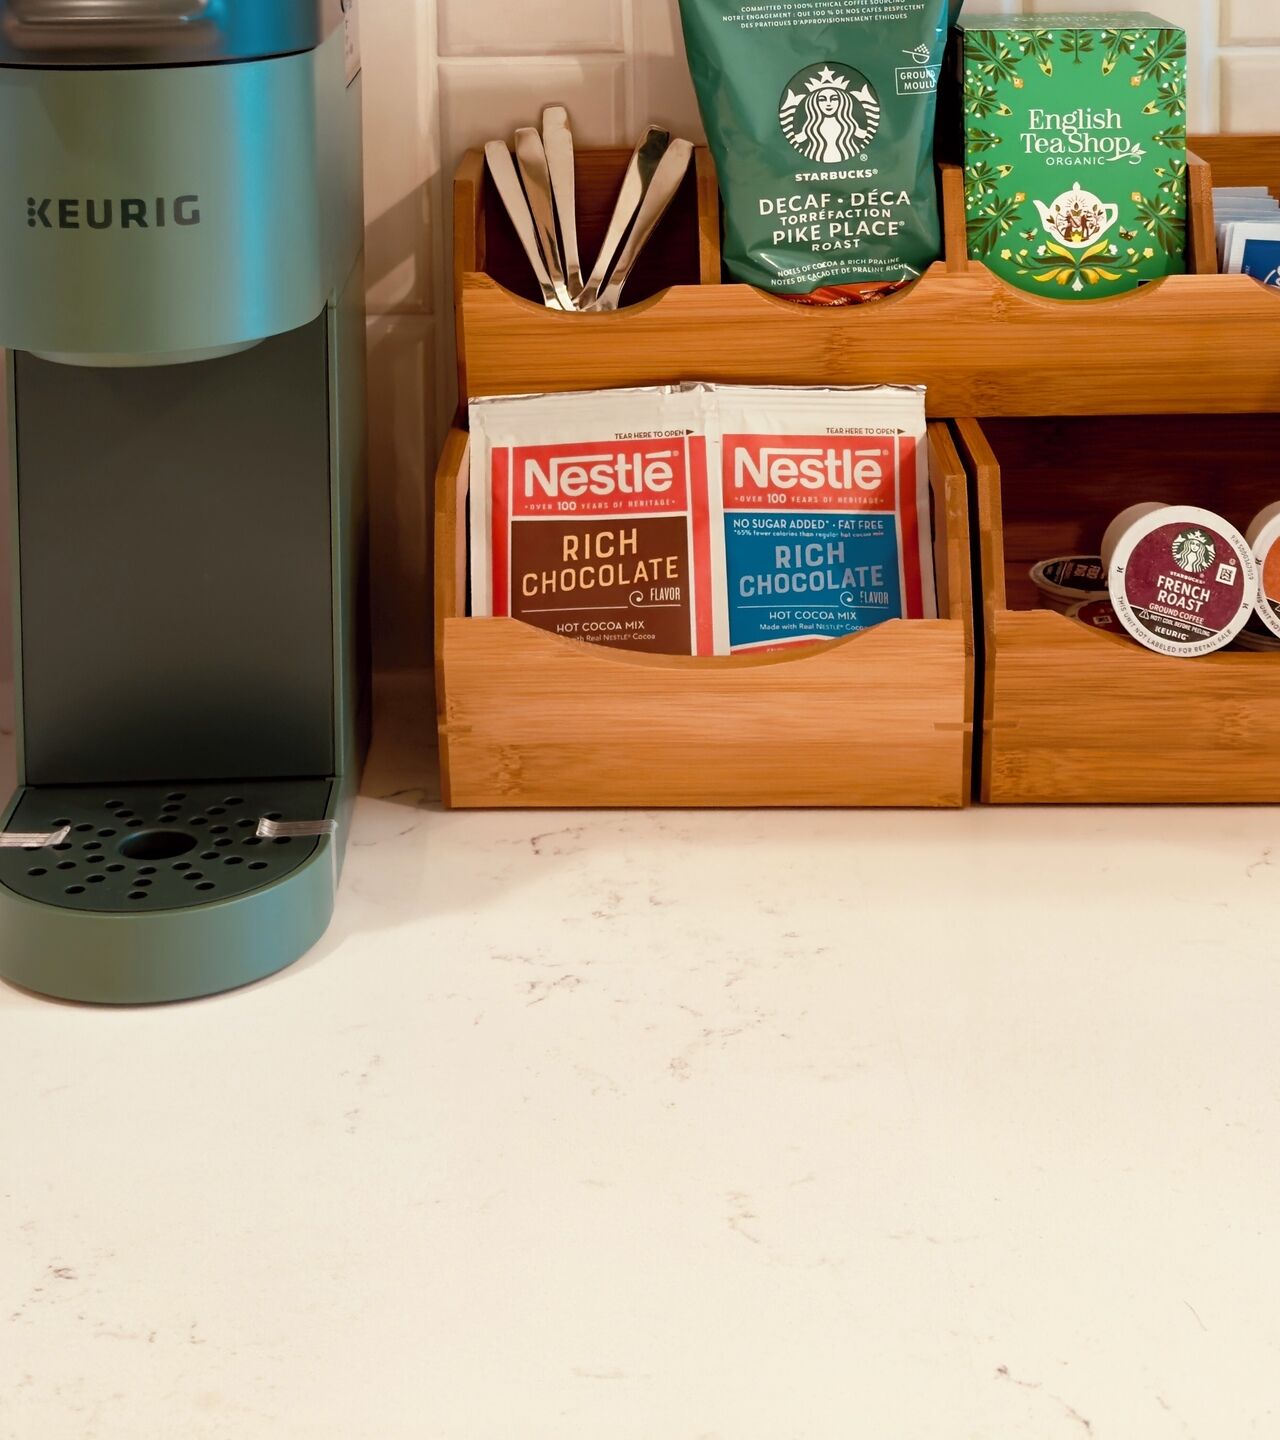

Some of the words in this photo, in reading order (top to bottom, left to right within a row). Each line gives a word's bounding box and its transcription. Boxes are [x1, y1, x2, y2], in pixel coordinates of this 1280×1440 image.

[741, 4, 782, 13] COMMITTED
[783, 3, 793, 11] TO
[794, 2, 813, 10] 100%
[815, 0, 842, 9] ETHICAL
[746, 11, 791, 21] ENGAGEMENT
[797, 10, 812, 18] QUE
[812, 9, 826, 17] 100
[835, 7, 845, 15] DE
[845, 6, 860, 15] NOS
[883, 3, 926, 13] RESPECTENT
[740, 21, 754, 29] DES
[754, 18, 792, 28] PRATIQUES
[904, 80, 936, 91] MOULU
[1028, 108, 1122, 135] English
[1021, 133, 1066, 154] Tea
[1068, 133, 1132, 161] Shop
[1046, 156, 1106, 166] ORGANIC
[759, 193, 832, 216] DECAF
[851, 189, 911, 207] DÉCA
[27, 195, 201, 229] KEURIG
[780, 208, 891, 227] TORRÉFACTION
[773, 224, 821, 246] PIKE
[812, 238, 861, 252] ROAST
[771, 277, 796, 286] NOTES
[796, 274, 807, 283] DE
[807, 270, 831, 282] CACAO
[831, 268, 839, 276] ET
[777, 267, 801, 277] NOTES
[812, 260, 838, 270] COCOA
[614, 432, 633, 440] TEAR
[633, 431, 653, 439] HERE
[664, 429, 685, 438] OPEN
[826, 427, 845, 435] TEAR
[524, 450, 674, 498] Nestlé
[734, 446, 883, 490] Nestlé
[557, 501, 577, 511] 100
[628, 499, 670, 508] HERITAGE
[739, 495, 763, 503] OVER
[767, 493, 787, 504] 100
[837, 496, 879, 504] HERITAGE
[733, 519, 750, 529] NO
[752, 519, 787, 529] SUGAR
[838, 520, 856, 530] FAT
[858, 520, 884, 530] FREE
[562, 528, 637, 562] RICH
[775, 541, 845, 569] RICH
[522, 556, 679, 596] CHOCOLATE
[739, 564, 884, 598] CHOCOLATE
[650, 587, 681, 601] FLAVOR
[1157, 575, 1211, 602] FRENCH
[860, 591, 889, 605] FLAVOR
[1157, 589, 1204, 613] ROAST
[770, 612, 792, 620] HOT
[794, 611, 835, 620] COCOA
[838, 612, 857, 620] MIX
[1149, 602, 1179, 617] GROUND
[1179, 611, 1205, 626] COFFEE
[556, 622, 579, 633] HOT
[581, 621, 622, 632] COCOA
[625, 620, 645, 630] MIX
[759, 623, 780, 631] Made
[845, 623, 866, 631] Coco
[1117, 595, 1127, 613] THIS
[1134, 627, 1147, 641] NOT
[1146, 637, 1177, 653] LABELED
[586, 634, 602, 642] Real
[632, 633, 656, 641] Cocoa
[1155, 626, 1190, 641] KEURIG
